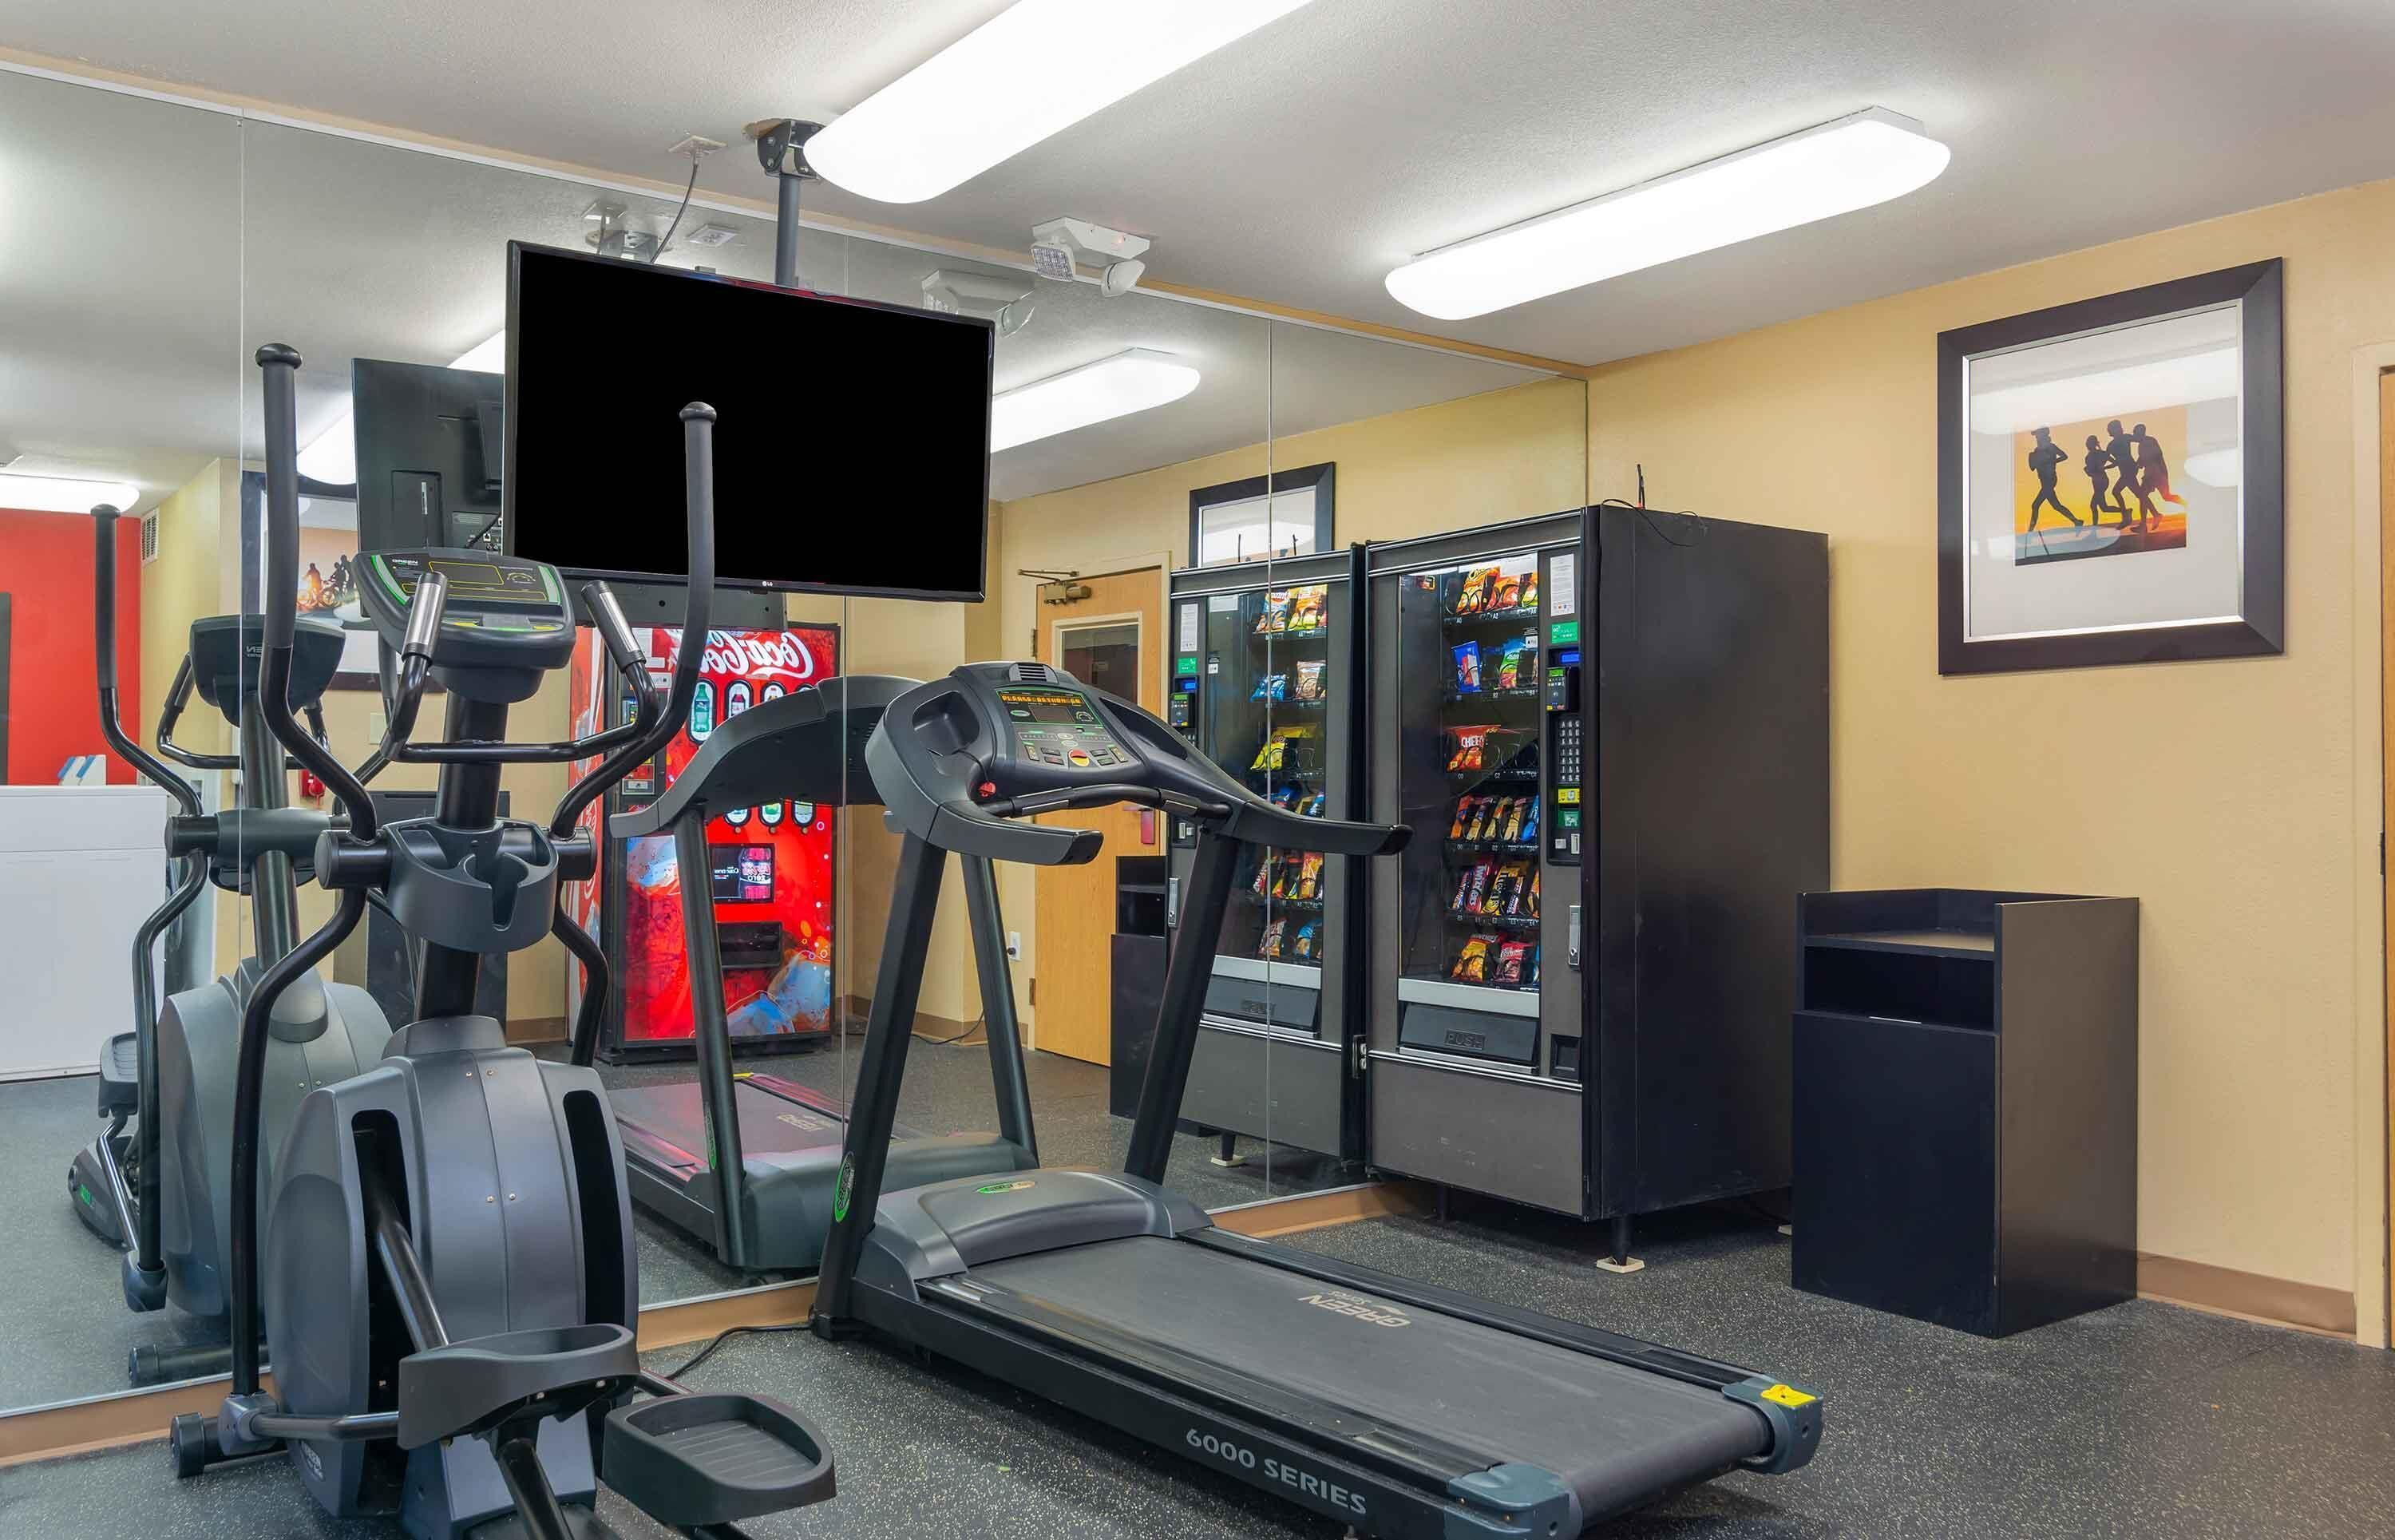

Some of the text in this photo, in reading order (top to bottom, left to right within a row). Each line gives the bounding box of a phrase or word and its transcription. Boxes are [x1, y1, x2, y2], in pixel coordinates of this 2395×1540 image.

[1297, 1294, 1411, 1328] GREEN
[1186, 1428, 1368, 1515] 6000 SERIES
